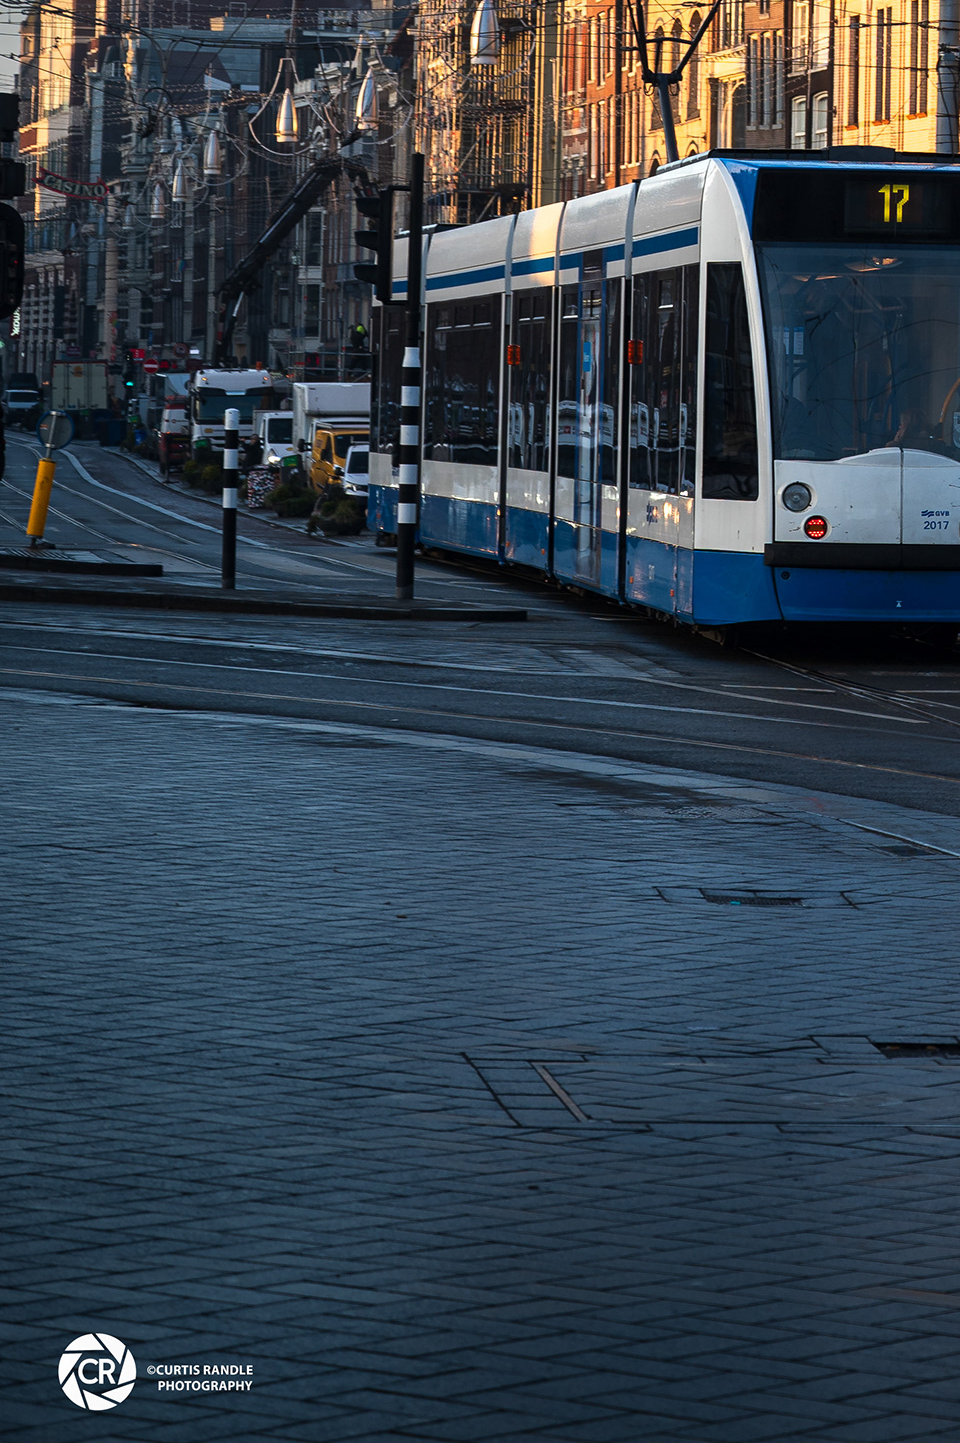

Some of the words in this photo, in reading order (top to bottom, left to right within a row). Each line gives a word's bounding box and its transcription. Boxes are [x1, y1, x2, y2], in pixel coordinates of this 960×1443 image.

[44, 175, 105, 197] CASINO
[878, 184, 909, 223] 17
[923, 520, 949, 530] 2017
